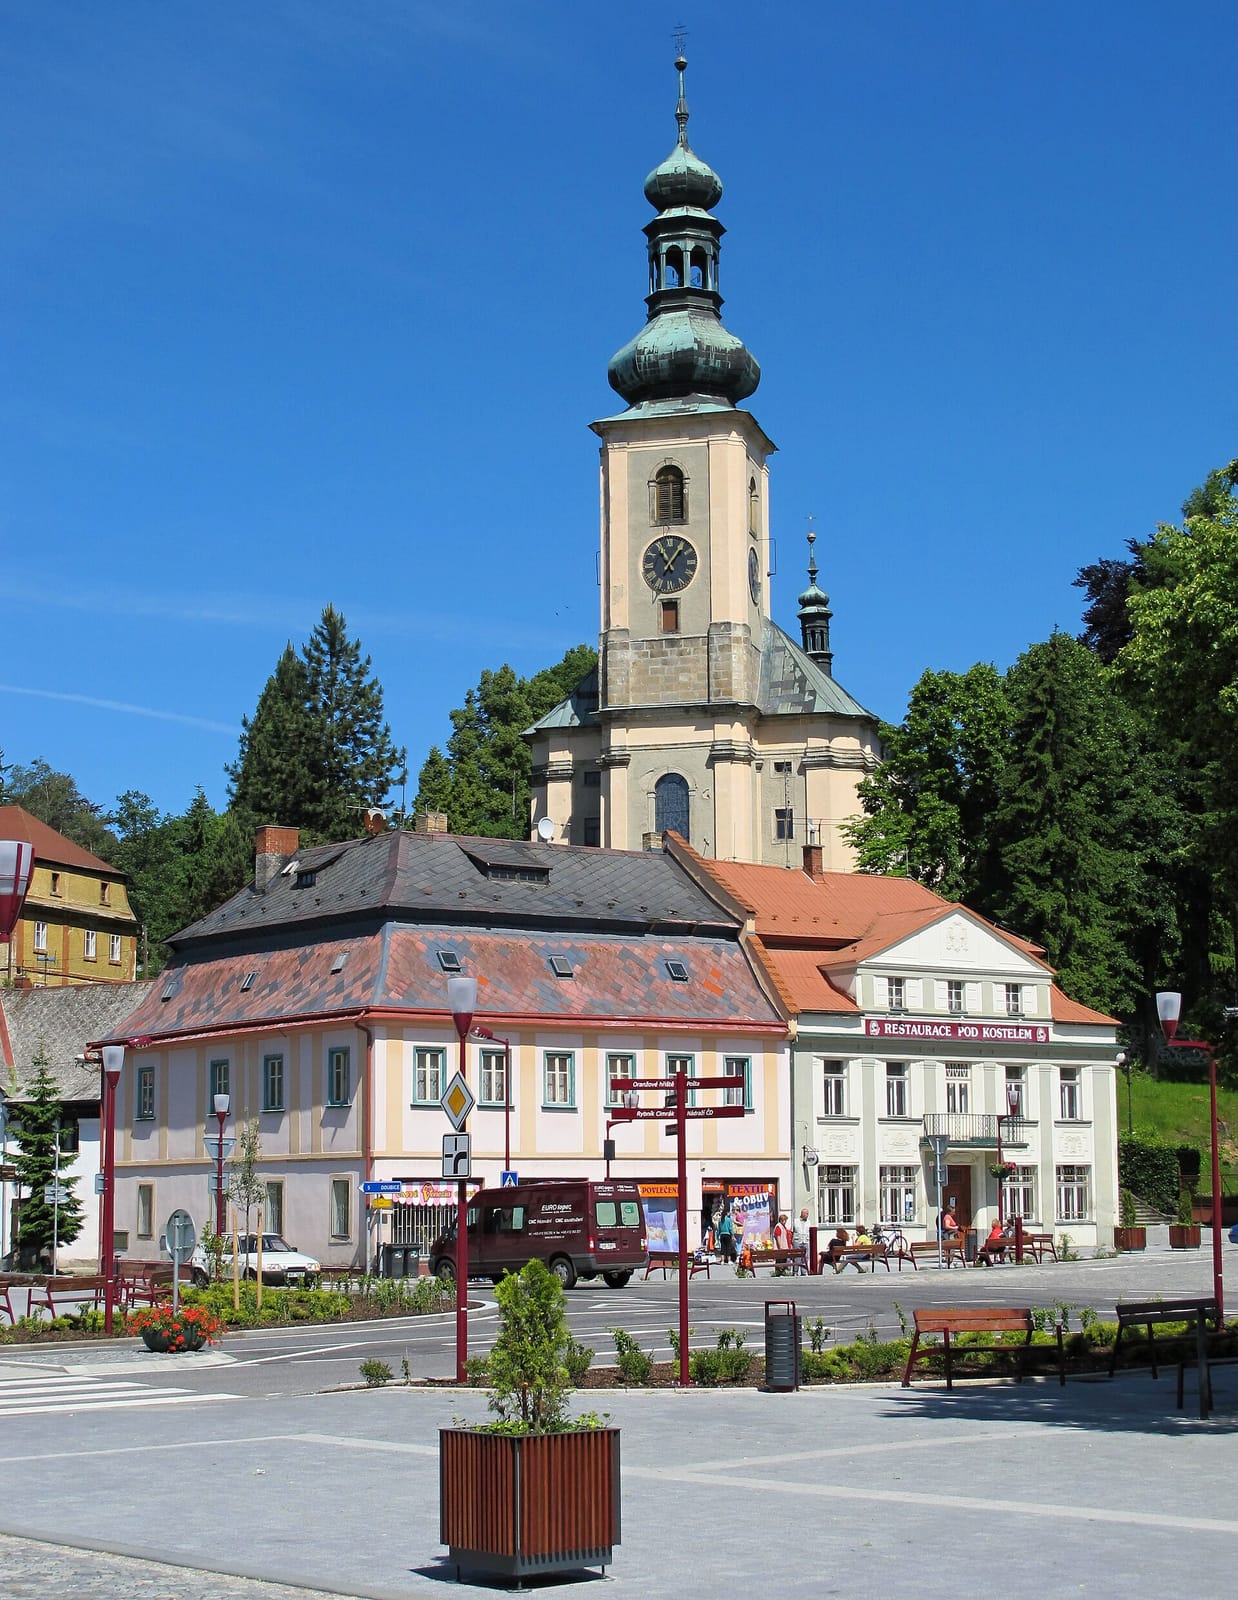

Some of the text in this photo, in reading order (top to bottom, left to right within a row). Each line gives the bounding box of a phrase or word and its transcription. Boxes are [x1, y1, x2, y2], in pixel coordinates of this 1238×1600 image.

[884, 1023, 1032, 1040] RESTAURACE POD KOSTELEM
[642, 1186, 677, 1194] POVLEČEN
